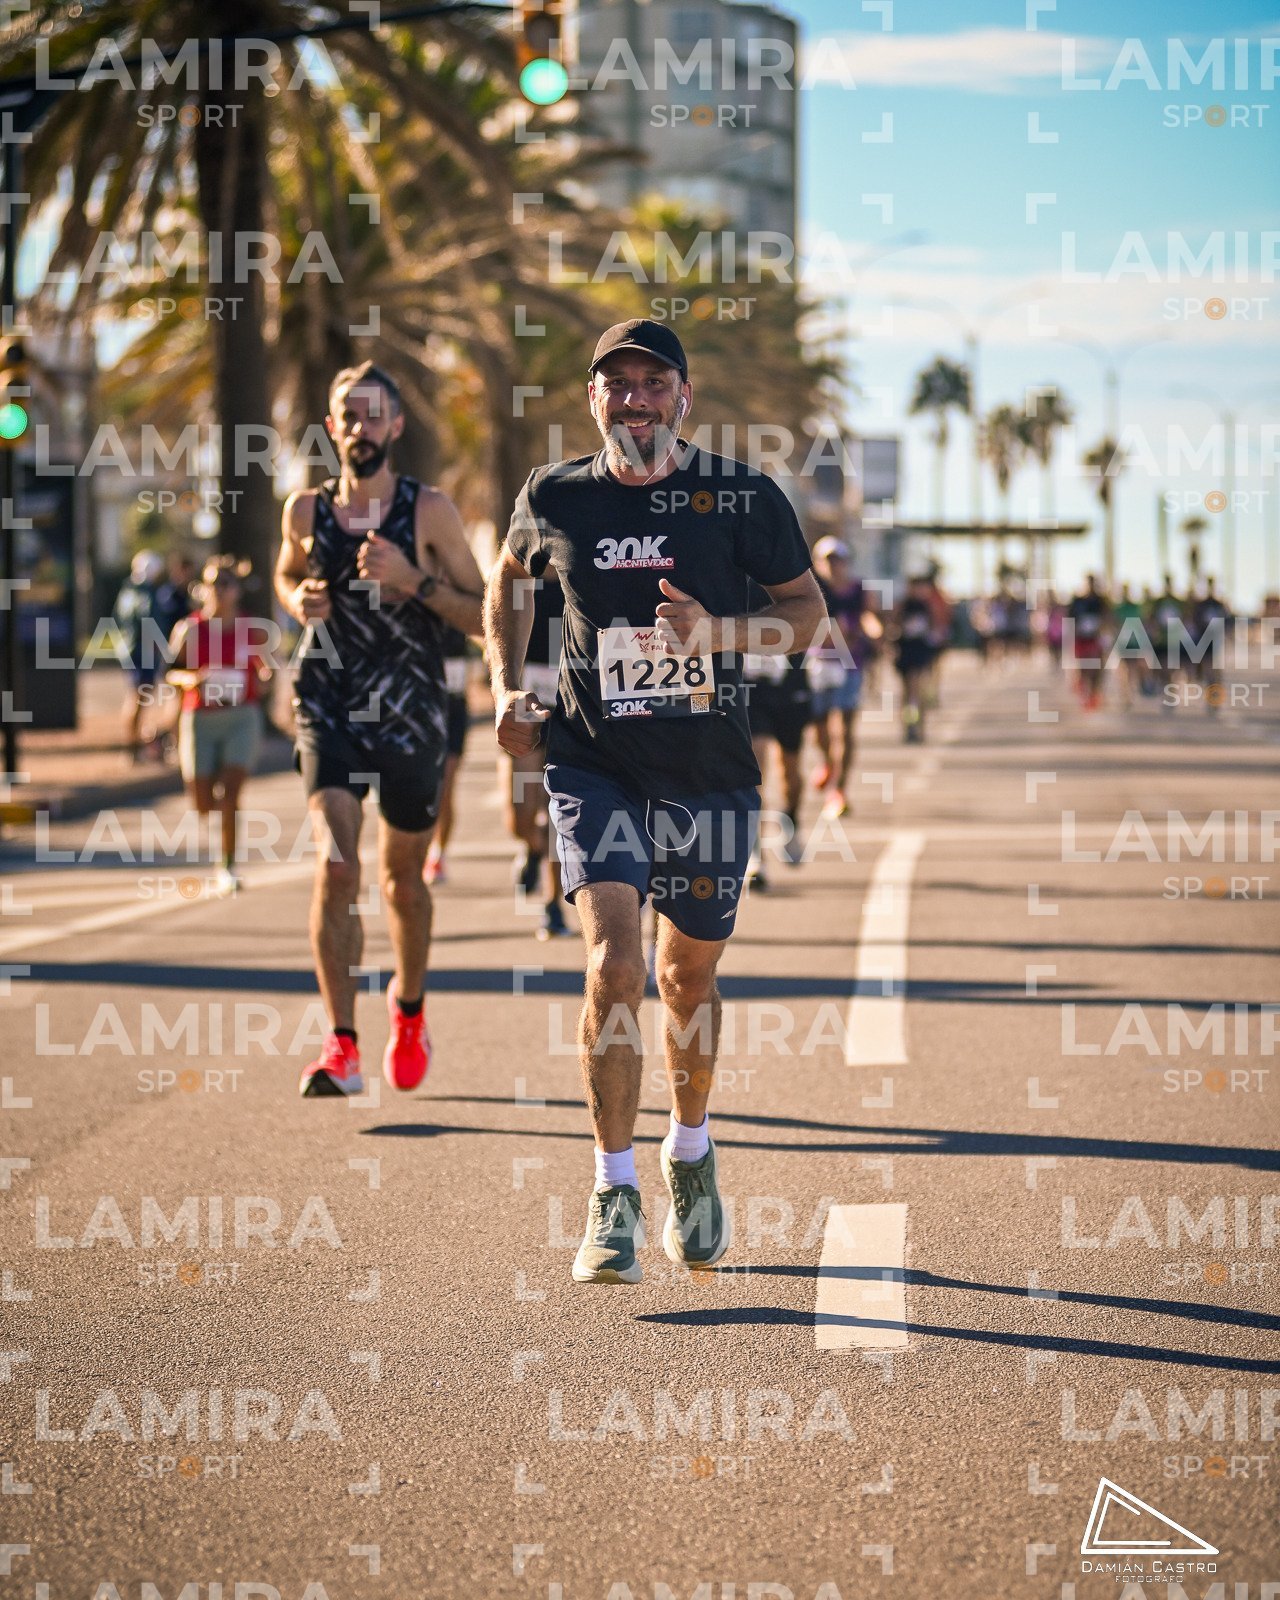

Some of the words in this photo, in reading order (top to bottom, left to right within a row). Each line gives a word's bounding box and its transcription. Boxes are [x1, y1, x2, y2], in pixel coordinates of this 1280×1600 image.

[594, 535, 668, 570] 30K
[608, 657, 706, 692] 1228
[610, 700, 648, 717] 30K
